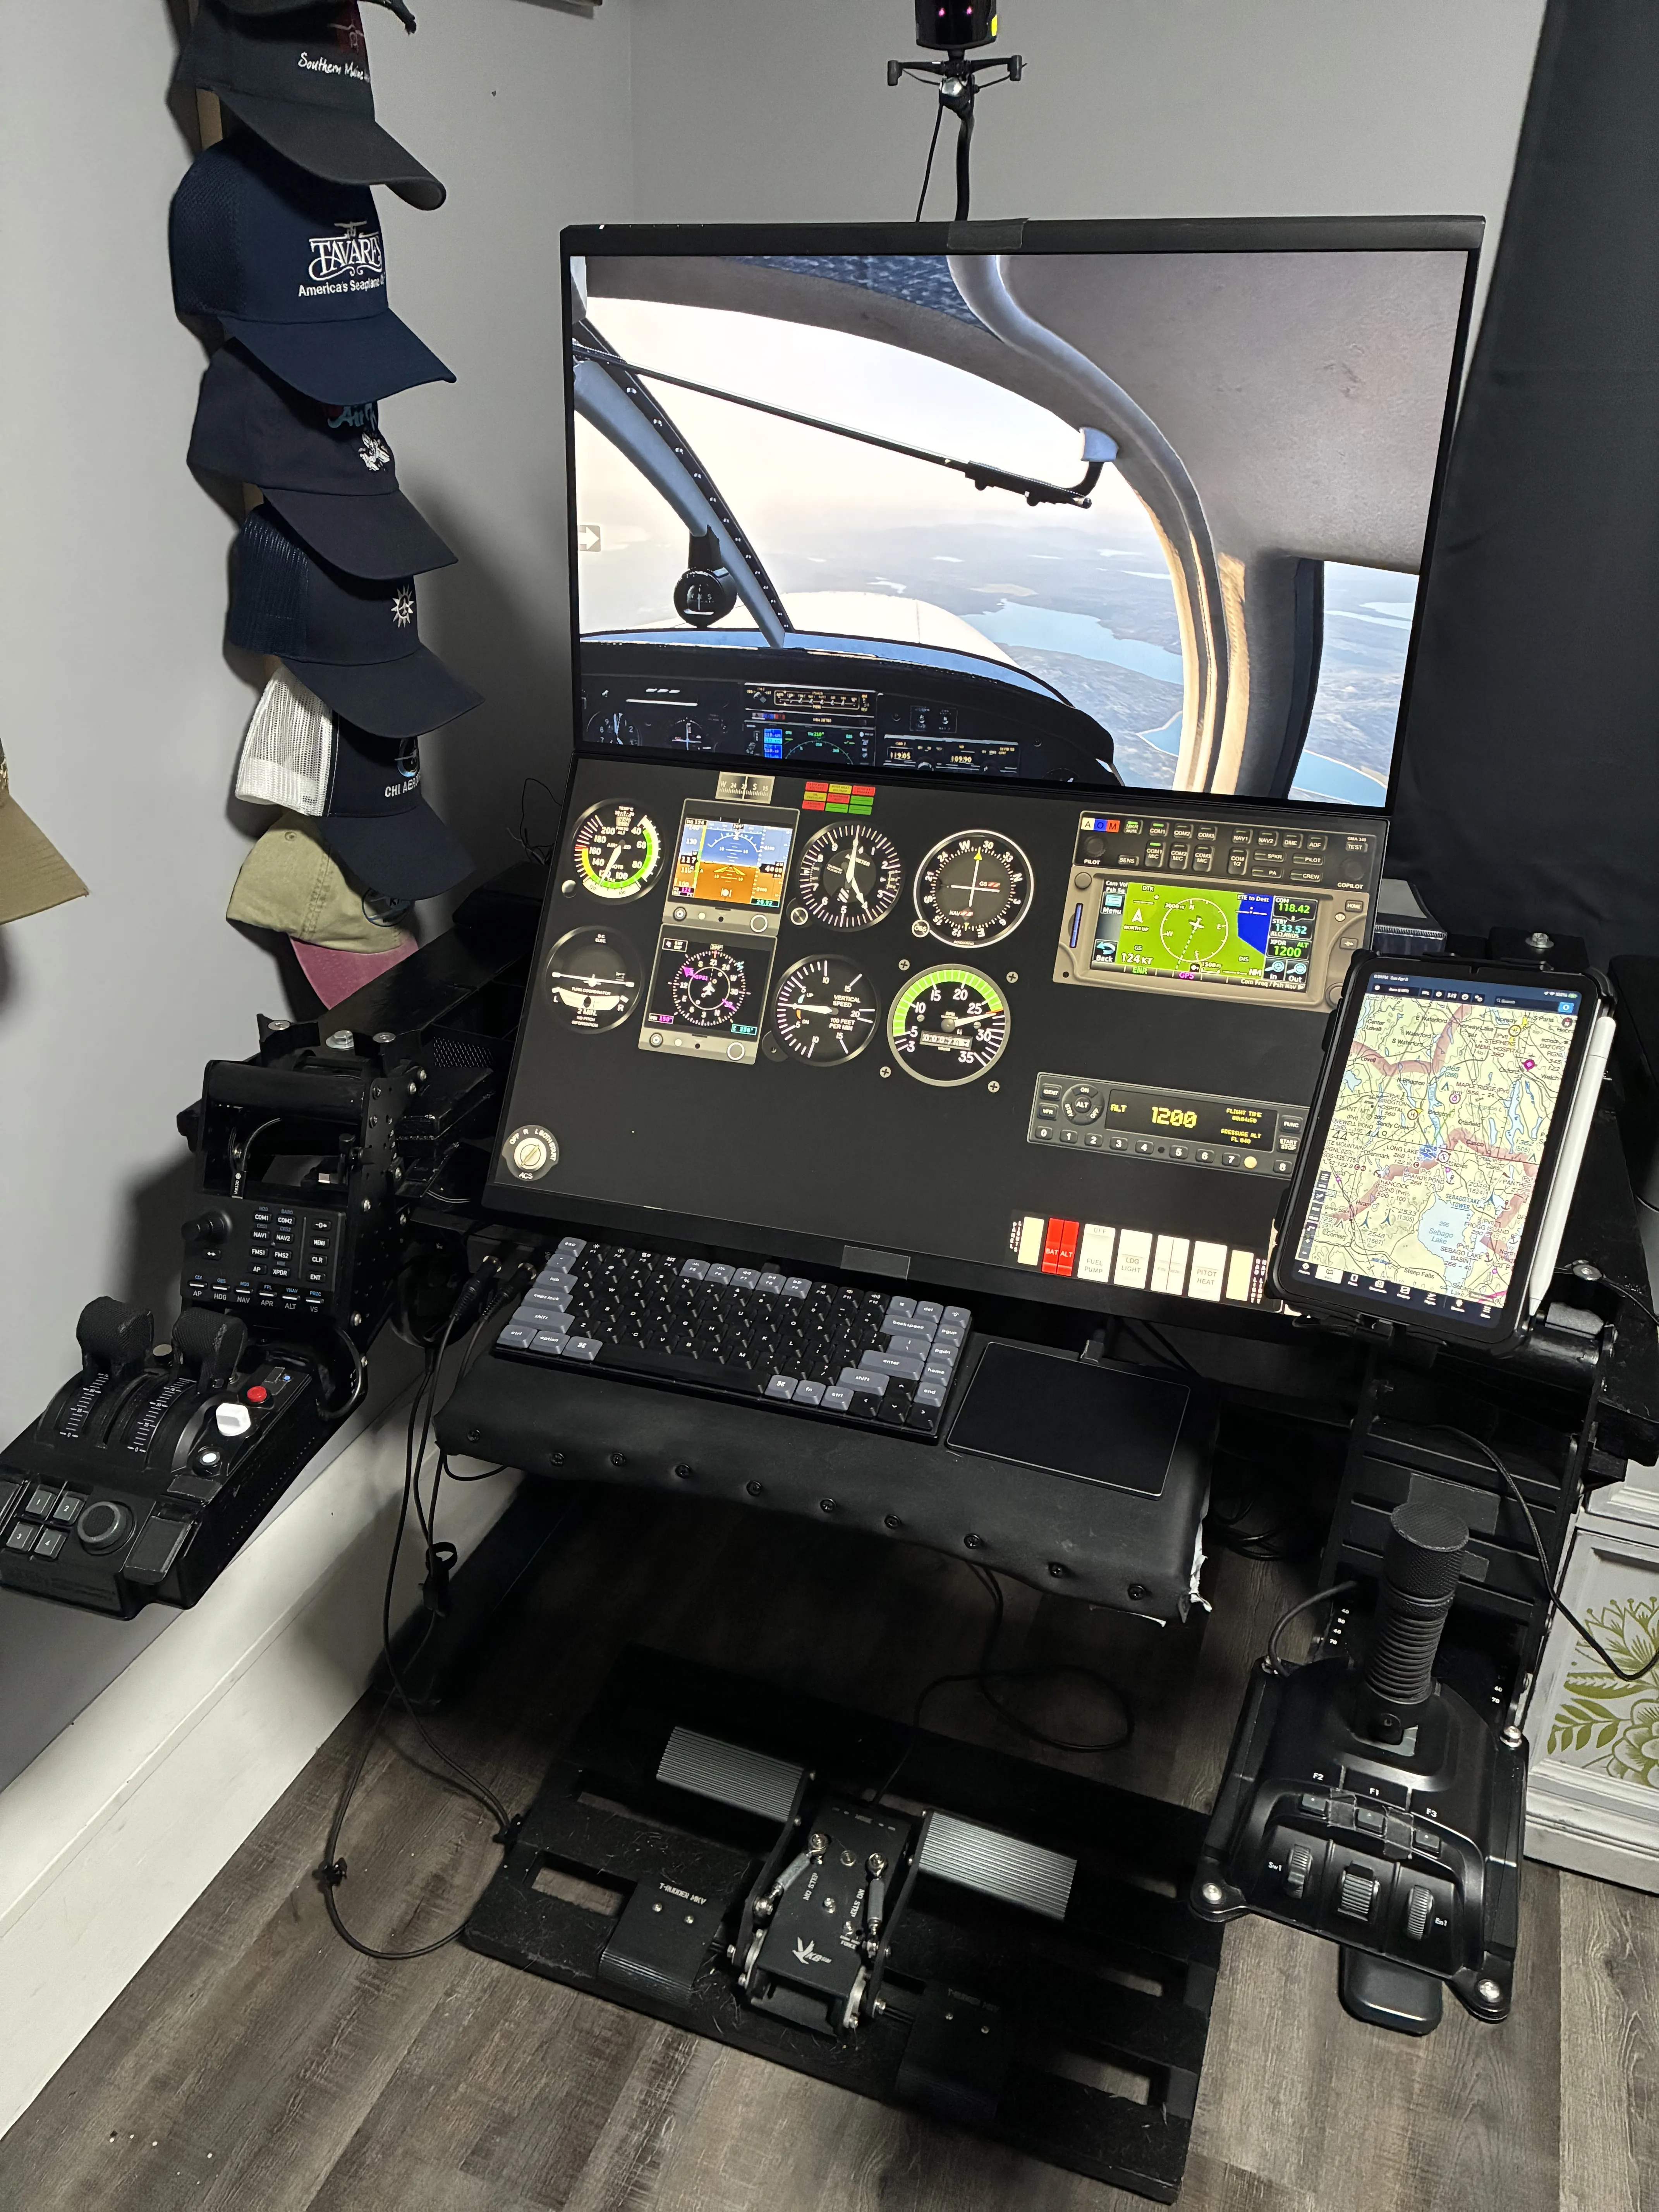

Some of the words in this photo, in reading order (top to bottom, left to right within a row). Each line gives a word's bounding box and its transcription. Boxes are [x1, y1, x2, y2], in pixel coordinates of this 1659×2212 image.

[298, 52, 342, 75] Southern
[299, 282, 348, 297] America's
[350, 278, 380, 292] Seaplane
[385, 784, 401, 797] CHI
[601, 827, 616, 835] 200
[631, 827, 641, 835] 40
[594, 835, 606, 843] 180
[636, 841, 647, 849] 60
[958, 840, 970, 851] W
[983, 840, 994, 849] 30
[589, 847, 601, 855] 160
[937, 851, 948, 862] 24
[1003, 852, 1013, 862] 33
[592, 858, 605, 866] 140
[632, 860, 642, 869] 80
[615, 872, 628, 880] 100
[925, 871, 934, 882] 21
[1012, 872, 1023, 882] N
[1278, 903, 1310, 914] 118.42
[1275, 924, 1307, 934] 133.52
[1274, 946, 1301, 957] 1200
[1121, 953, 1141, 963] 124
[1141, 957, 1153, 965] KT
[1132, 966, 1148, 974] ENR
[1179, 972, 1194, 980] GPS
[834, 994, 861, 1003] VERTICAL
[930, 989, 941, 1001] 15
[953, 988, 968, 1001] 20
[915, 1001, 926, 1013] 10
[967, 1002, 982, 1015] 25
[975, 1029, 992, 1042] 30
[958, 1051, 974, 1063] 35
[1110, 1104, 1127, 1113] ALT
[1152, 1106, 1197, 1128] 1200
[1366, 1150, 1389, 1159] Denmark
[1403, 1172, 1427, 1181] BRANDY
[1380, 1180, 1409, 1189] HANCOCK
[1446, 1194, 1467, 1202] SEBAGO
[1429, 1228, 1453, 1238] Sebago
[1431, 1236, 1447, 1244] Lake
[1084, 1266, 1103, 1274] PUMP
[1197, 1269, 1217, 1277] PITOT
[1404, 1267, 1420, 1277] Steep
[1421, 1271, 1435, 1279] Falls
[1197, 1278, 1215, 1286] HEAT
[893, 1320, 924, 1329] backspace
[1313, 1772, 1324, 1781] F2
[1370, 1788, 1379, 1796] F1
[1426, 1808, 1437, 1818] F3
[1268, 1862, 1281, 1872] Sw1
[1435, 1917, 1447, 1926] En1
